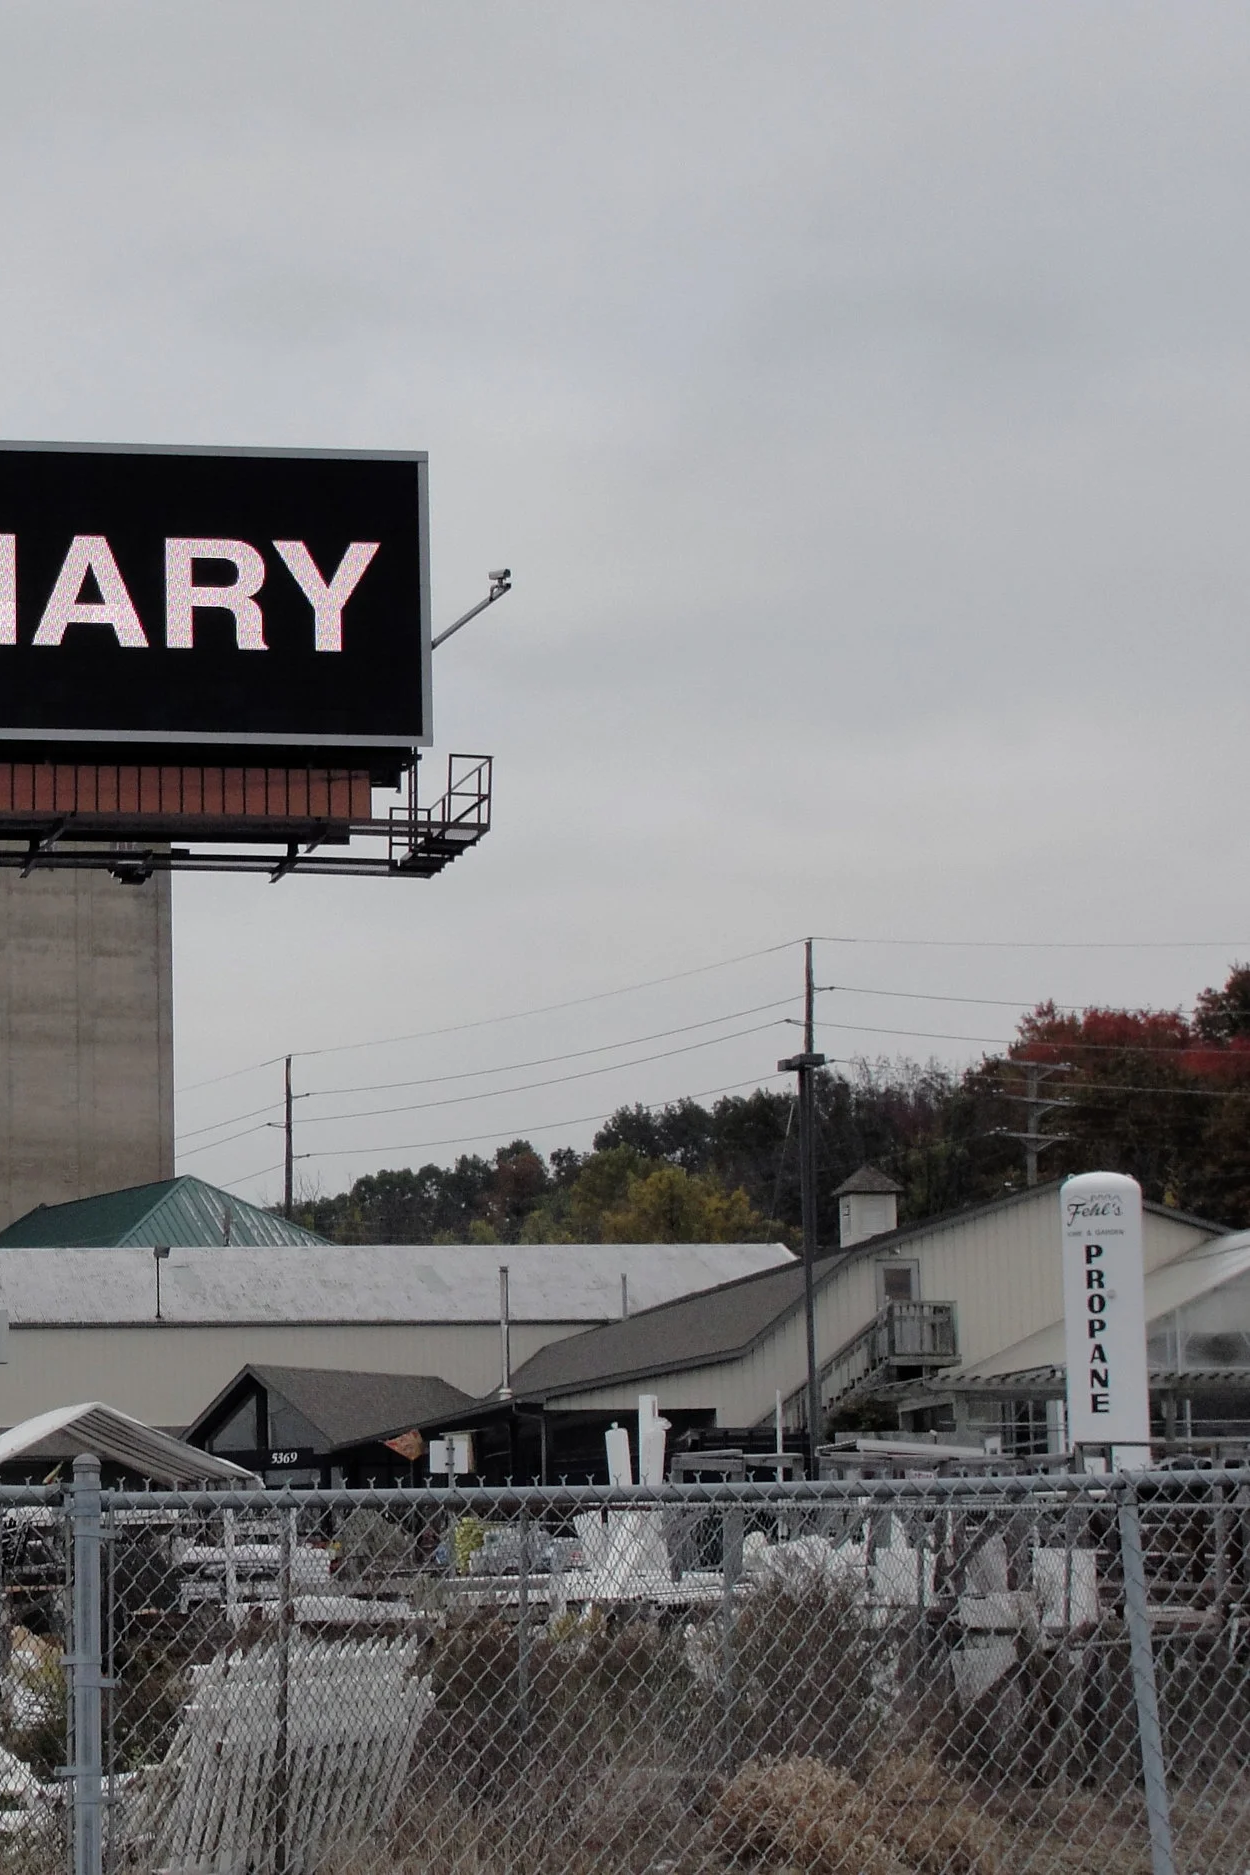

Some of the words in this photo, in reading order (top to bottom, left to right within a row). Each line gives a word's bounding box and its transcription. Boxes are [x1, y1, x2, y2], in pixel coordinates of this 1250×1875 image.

[1066, 1202, 1124, 1227] Fehl's
[1085, 1244, 1110, 1413] PROPANE
[270, 1451, 298, 1464] 5369
